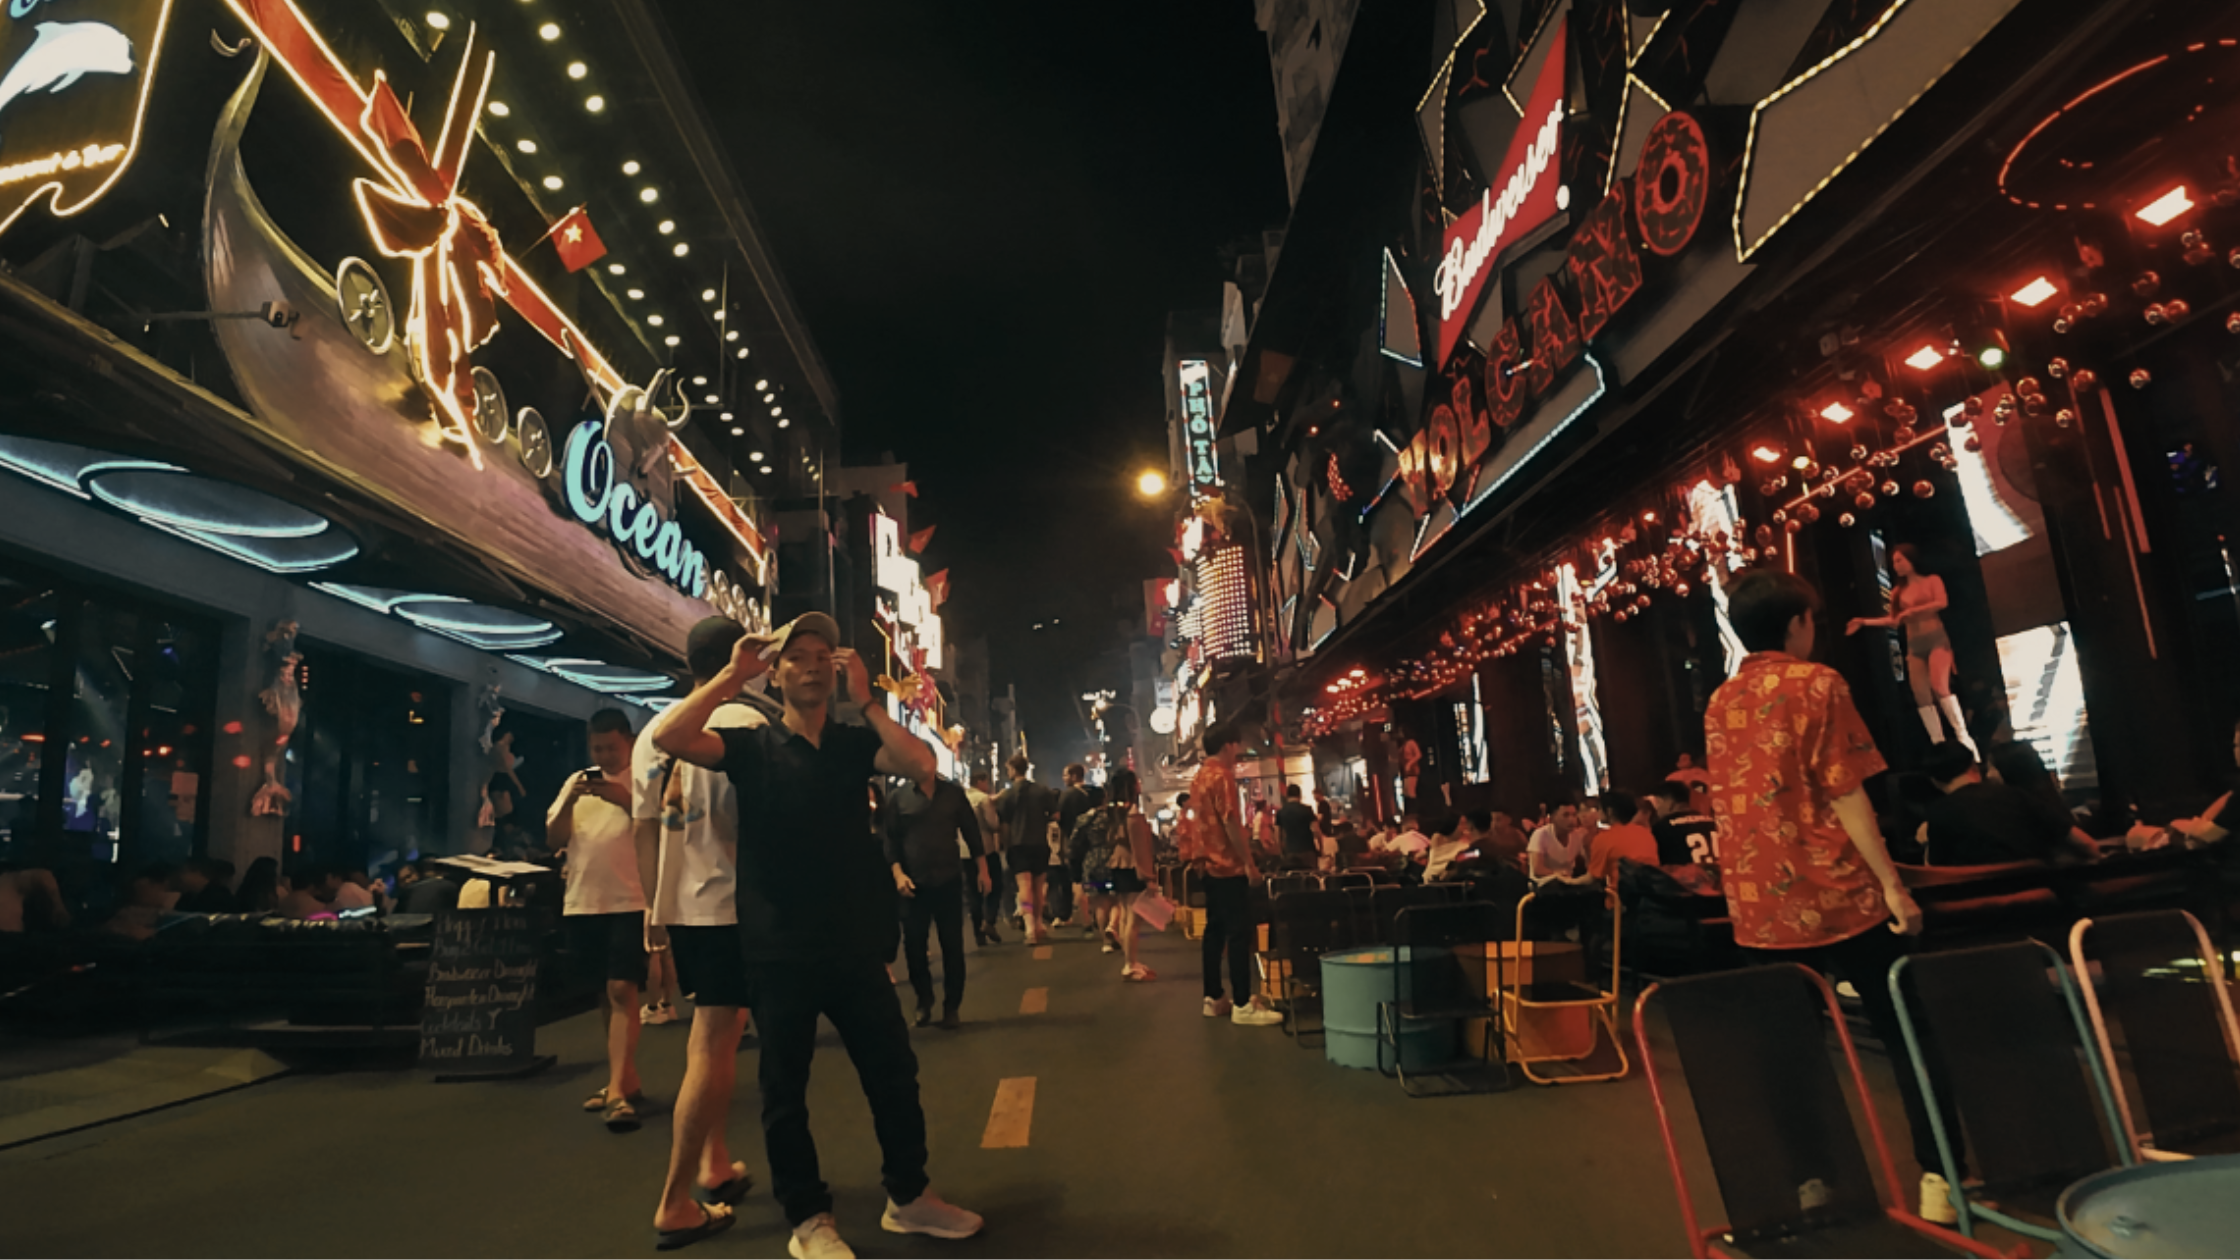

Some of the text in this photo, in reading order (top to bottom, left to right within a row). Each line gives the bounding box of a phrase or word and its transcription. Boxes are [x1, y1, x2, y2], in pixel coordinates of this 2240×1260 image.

[1434, 99, 1564, 322] Budweiser
[1400, 111, 1709, 519] VOLCANO
[565, 420, 704, 598] Ocean
[466, 1033, 513, 1056] Drinks
